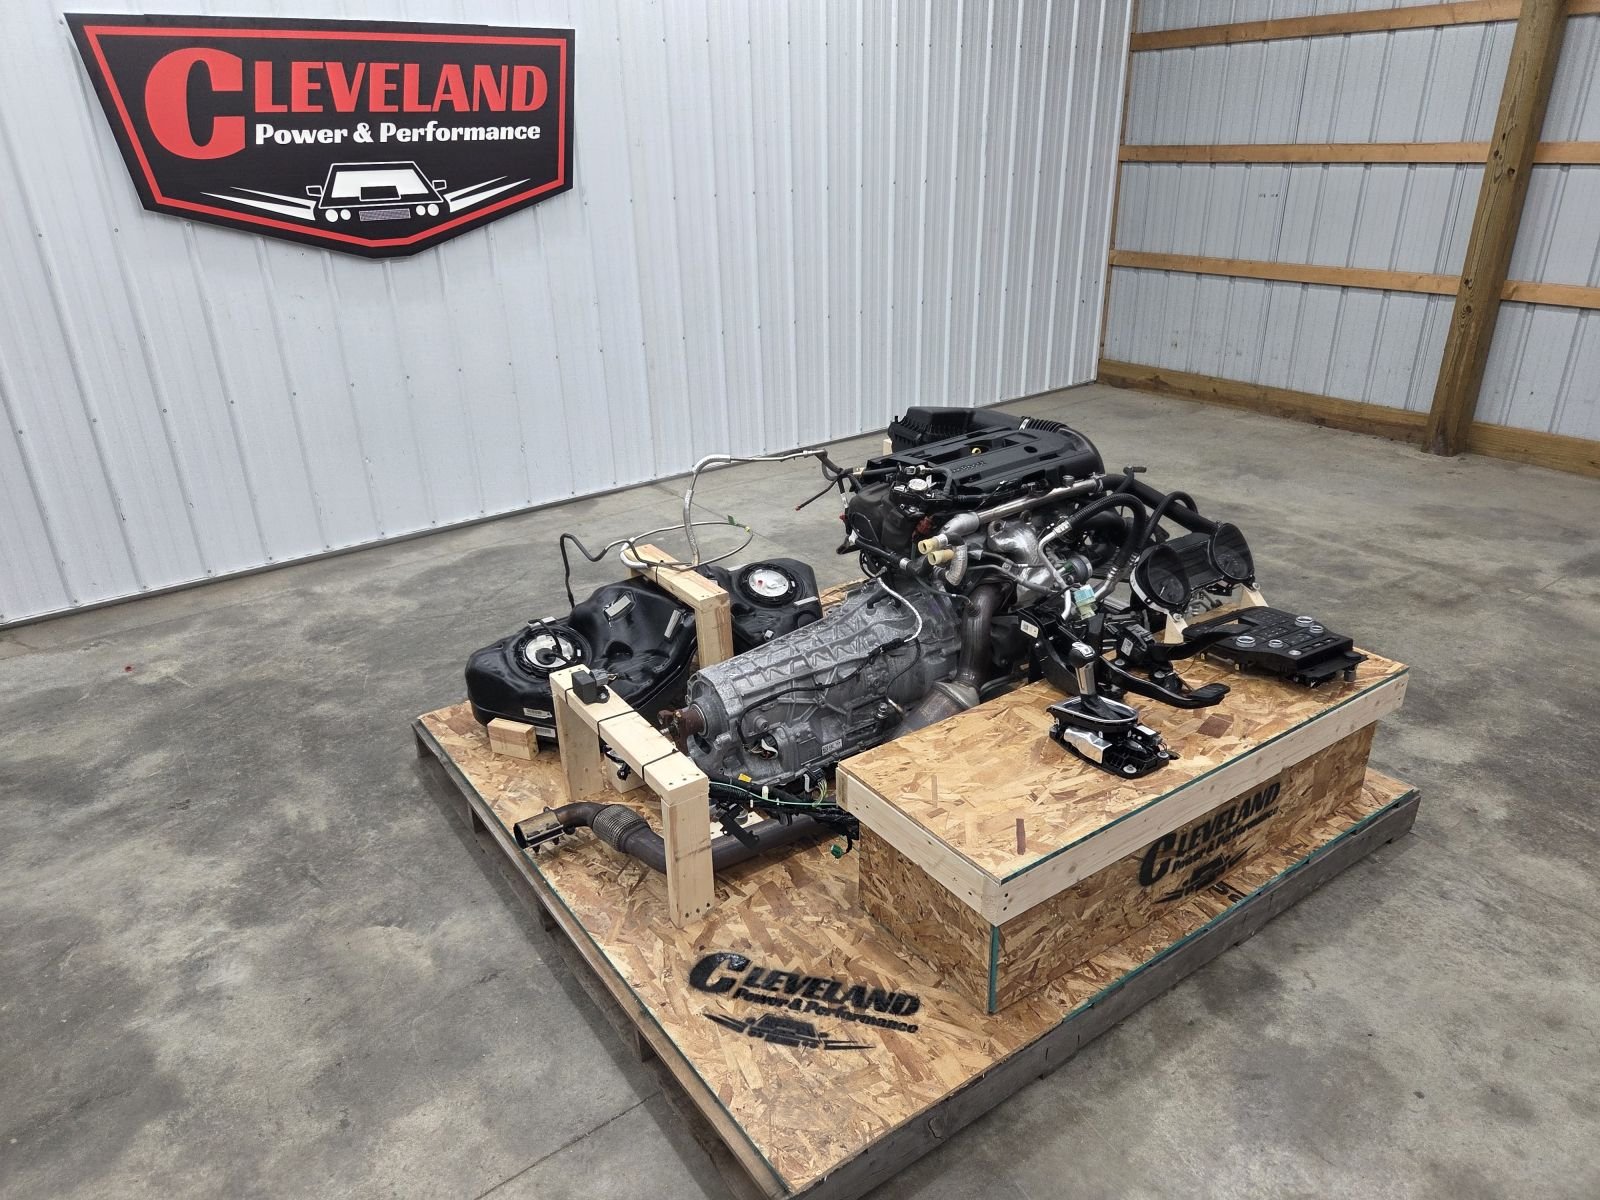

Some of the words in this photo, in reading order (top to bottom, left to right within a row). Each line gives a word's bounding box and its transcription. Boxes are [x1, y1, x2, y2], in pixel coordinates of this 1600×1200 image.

[145, 47, 549, 160] CLEVELAND
[255, 123, 347, 145] Power
[353, 123, 374, 144] &
[379, 120, 541, 143] Performance
[1139, 782, 1280, 887] CLEVELAND
[689, 952, 920, 1016] CLEVELAND
[733, 988, 789, 1007] Power
[804, 1000, 918, 1034] Performance
